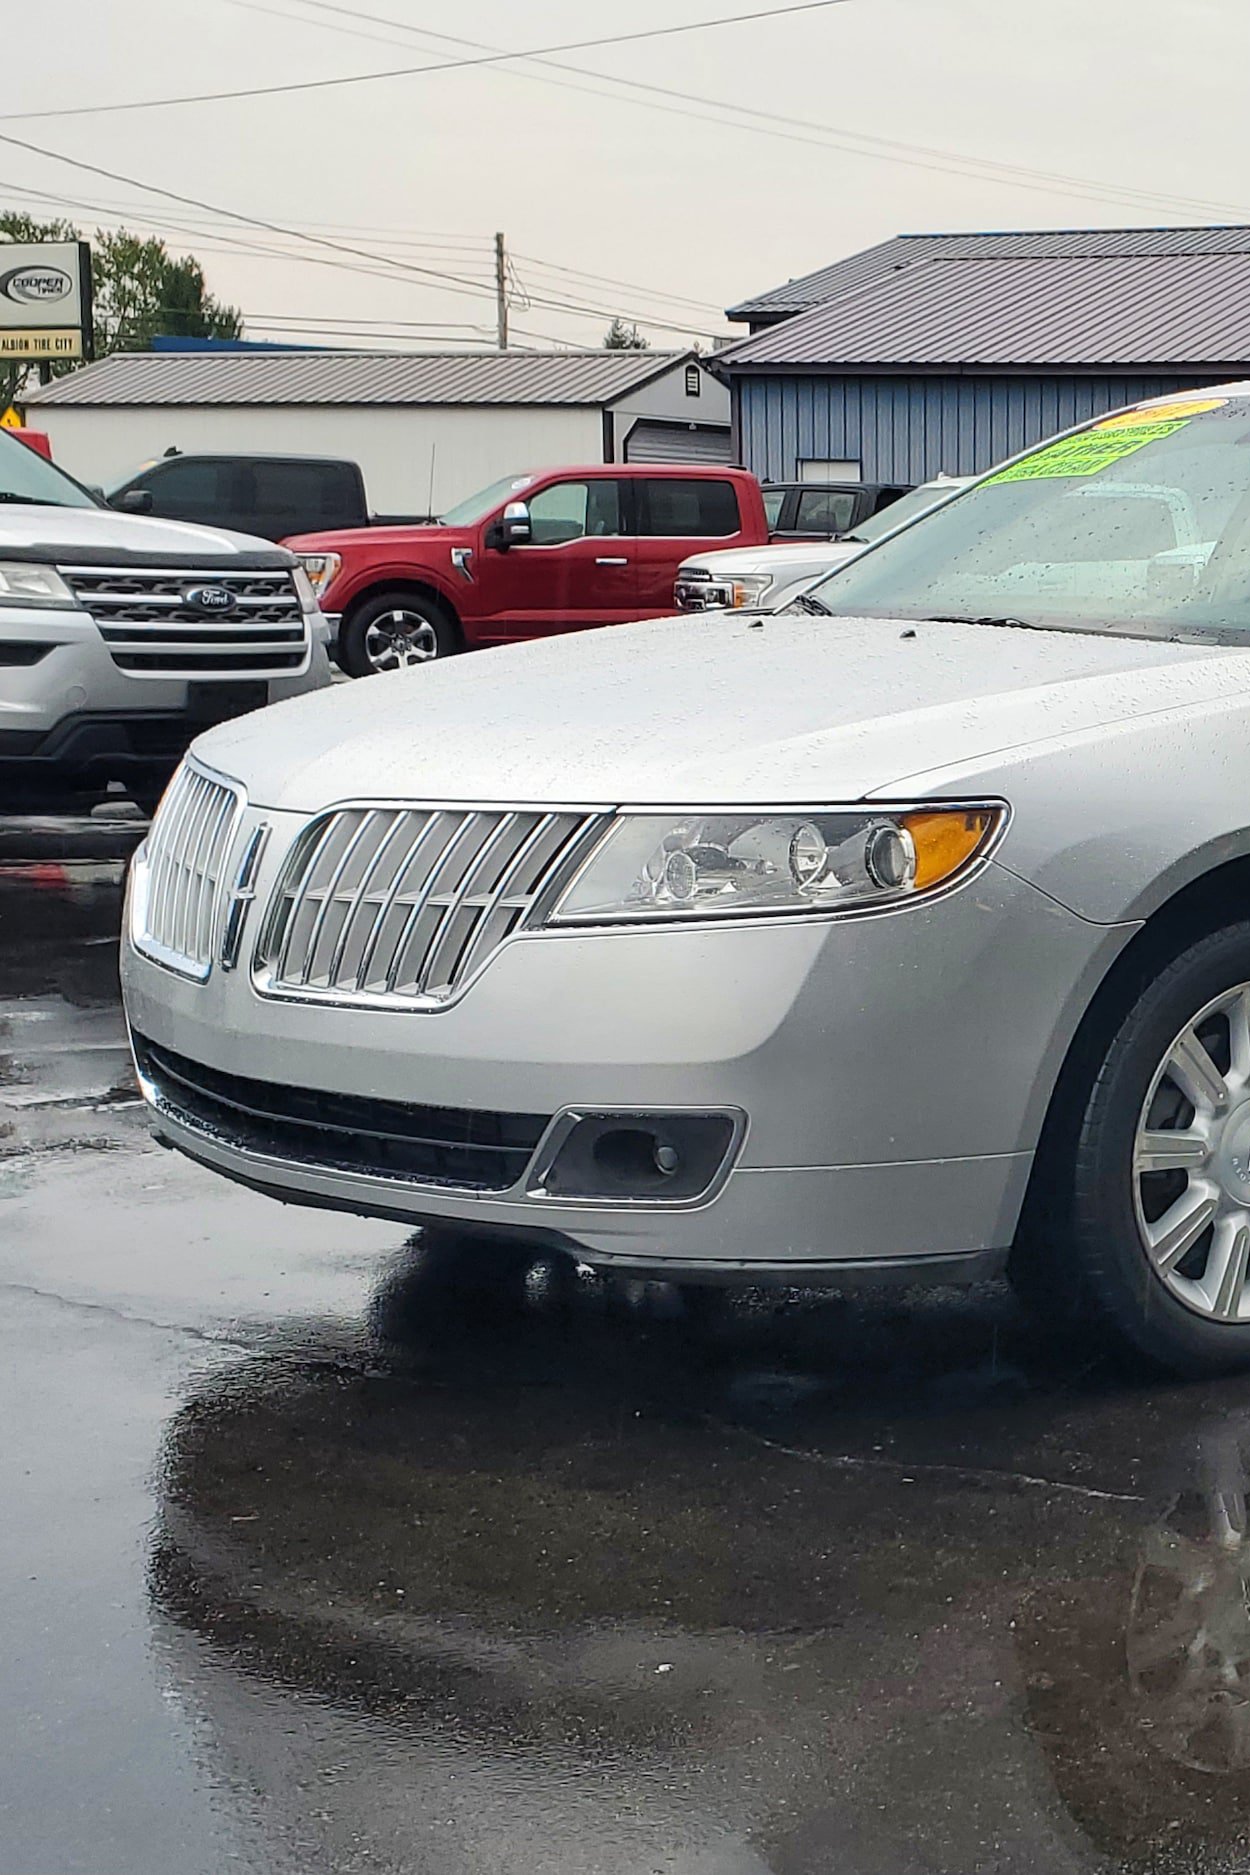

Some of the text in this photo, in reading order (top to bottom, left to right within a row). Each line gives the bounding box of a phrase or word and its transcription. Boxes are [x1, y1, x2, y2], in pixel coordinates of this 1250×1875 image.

[13, 277, 63, 287] COOPER
[2, 337, 73, 350] ALBION TIRE CITY
[201, 589, 228, 605] Ford
